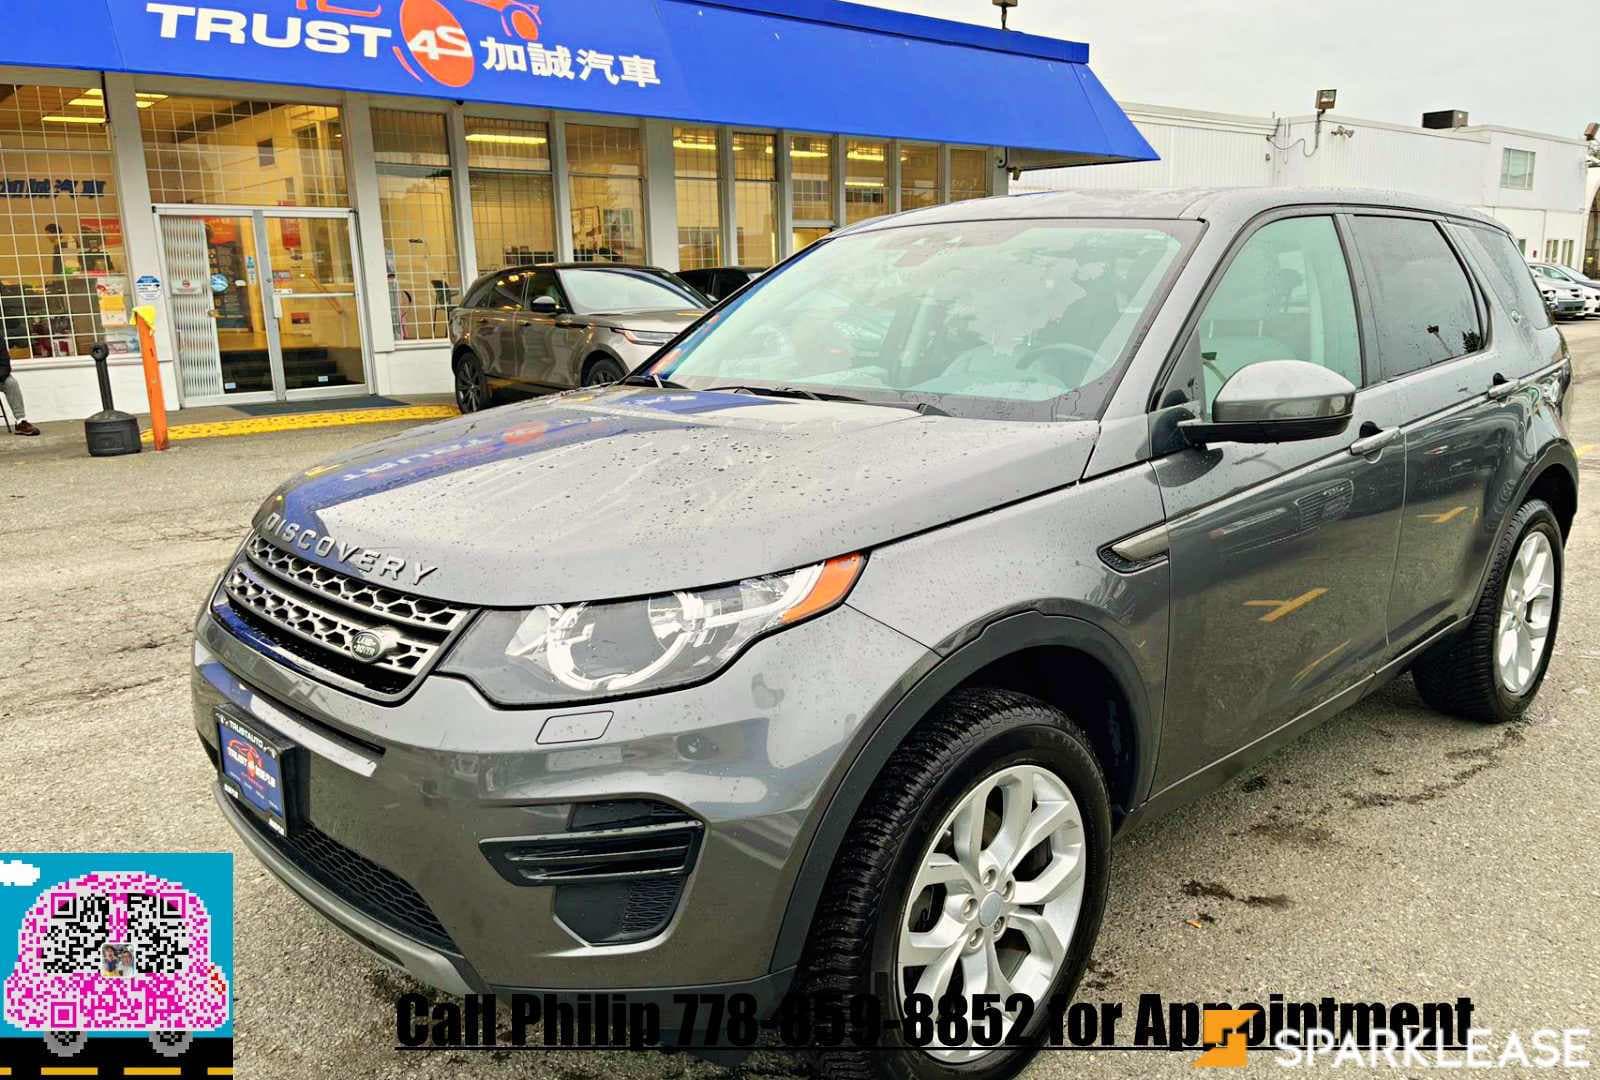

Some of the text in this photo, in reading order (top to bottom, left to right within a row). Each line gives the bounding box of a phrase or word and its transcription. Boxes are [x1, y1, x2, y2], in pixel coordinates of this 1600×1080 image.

[146, 3, 473, 61] TRUST 4S
[479, 37, 661, 88] 加誠汽車
[265, 512, 438, 586] DISCOVERY
